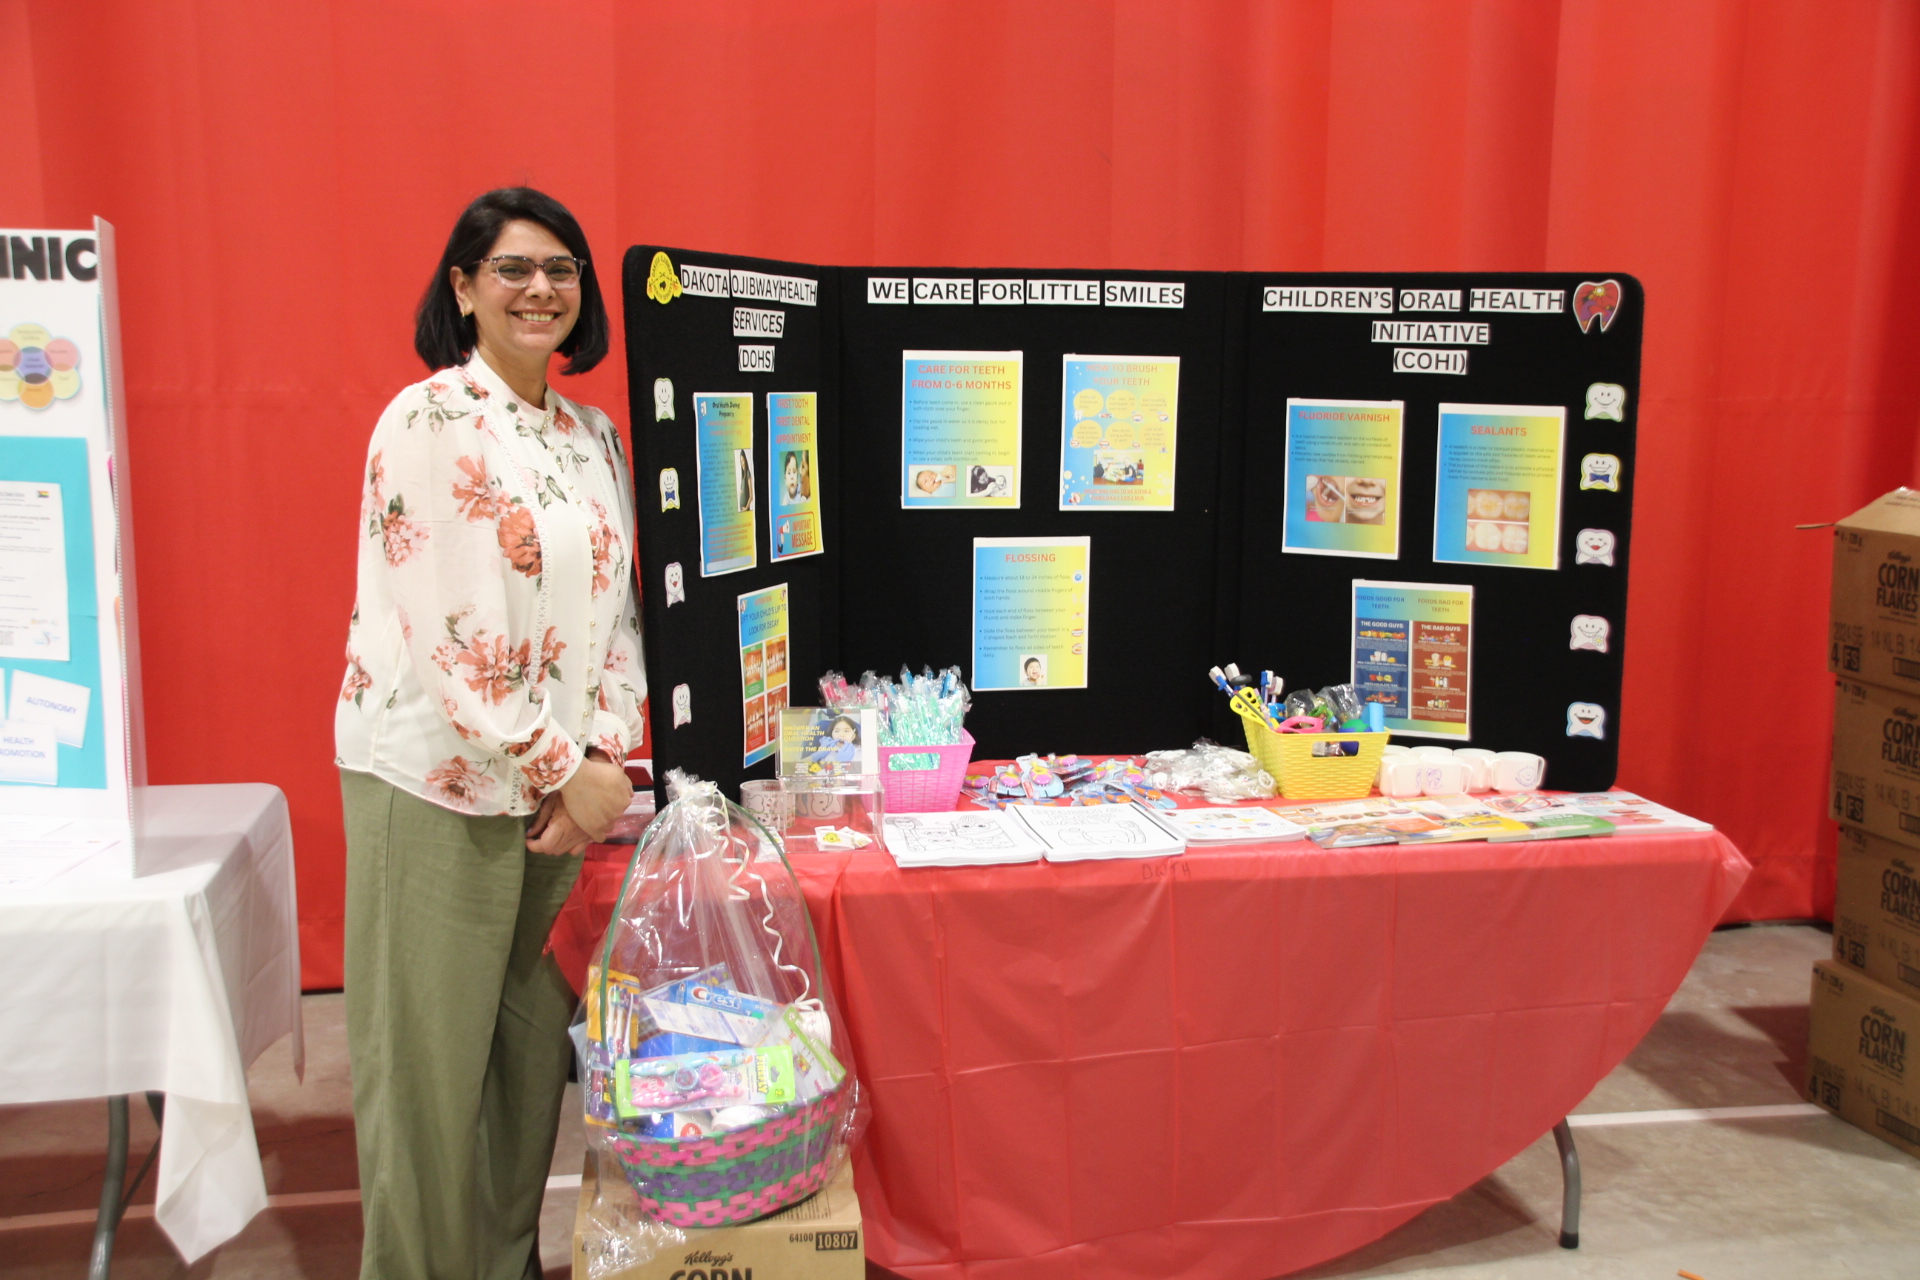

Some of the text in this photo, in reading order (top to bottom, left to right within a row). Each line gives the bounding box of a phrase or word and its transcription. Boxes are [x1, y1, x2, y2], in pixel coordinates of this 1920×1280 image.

[682, 269, 817, 303] DAKOTA OJIBWAY HEALTH
[872, 281, 1183, 304] WE CARE FOR LITTLE SMILES
[1400, 292, 1460, 310] ORAL
[1470, 292, 1563, 311] HEALTH
[733, 310, 783, 333] SERVICES
[1372, 323, 1488, 343] INITIATIVE
[738, 347, 775, 371] (DOHS)
[1393, 351, 1466, 373] (COHI)
[918, 364, 1006, 375] CARE FOR TEETH
[1086, 364, 1158, 373] HOW TO BRUSH
[911, 380, 1012, 390] FROM 0-6 MONTHS
[1093, 377, 1150, 386] YOUR TEETH
[776, 398, 809, 409] FIRST TOOTH
[776, 415, 811, 427] FIRST DENTAL
[1298, 410, 1390, 423] FLUORIDE VARNISH
[776, 432, 811, 445] APPOINTMENT
[1470, 425, 1527, 436] SEALANTS
[791, 530, 813, 549] MESSAGE
[1005, 553, 1056, 562] FLOSSING
[1877, 562, 1920, 592] CORN
[1876, 587, 1919, 613] FLAKES
[748, 611, 760, 621] YOUR
[749, 625, 759, 636] LOOK
[767, 619, 780, 630] DECAY
[26, 696, 77, 714] AUTONOMY
[3, 736, 35, 745] HEALTH
[1881, 742, 1920, 769] FLAKE
[693, 987, 742, 1009] Crest
[1860, 1014, 1906, 1054] CORN
[1859, 1036, 1905, 1073] FLAKES
[755, 1055, 769, 1094] FIREFLY
[789, 1231, 857, 1249] 64100 10807
[684, 1250, 733, 1266] Kellogg's
